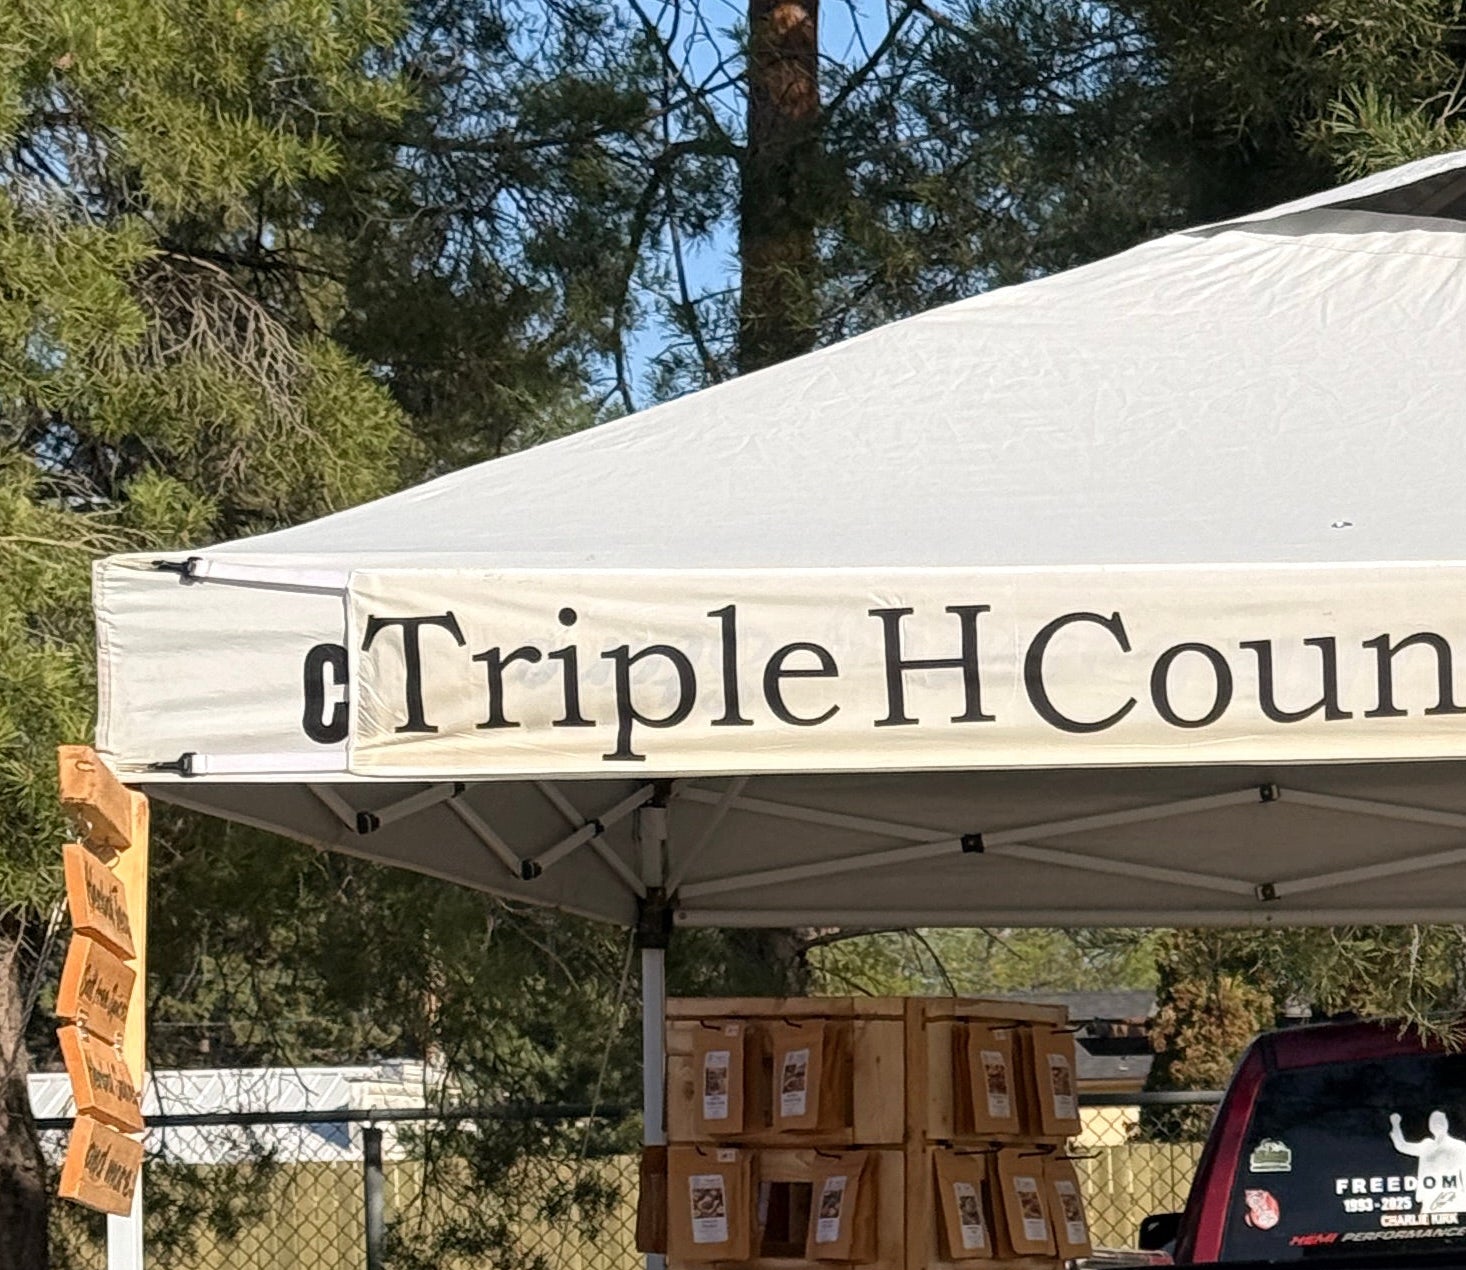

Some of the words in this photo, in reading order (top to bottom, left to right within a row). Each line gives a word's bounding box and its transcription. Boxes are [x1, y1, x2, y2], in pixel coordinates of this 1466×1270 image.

[362, 604, 841, 762] Triple
[867, 604, 996, 727] H
[1336, 1174, 1457, 1195] FREEDOM
